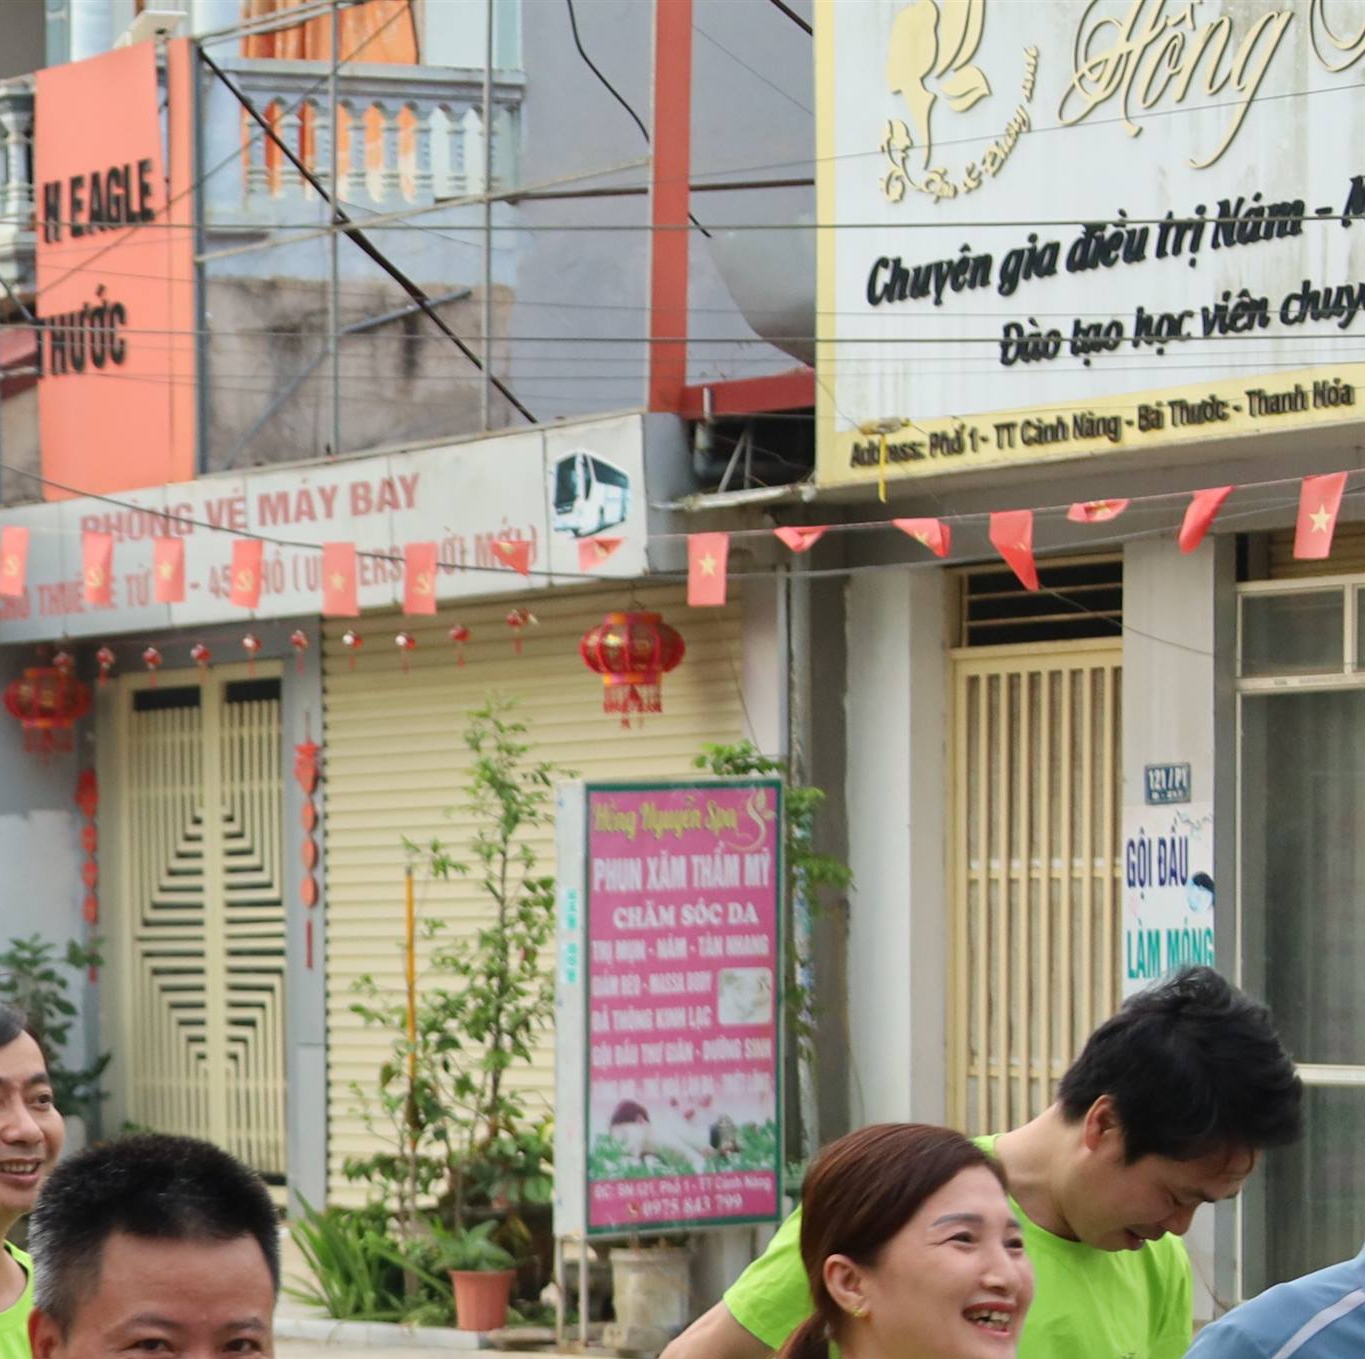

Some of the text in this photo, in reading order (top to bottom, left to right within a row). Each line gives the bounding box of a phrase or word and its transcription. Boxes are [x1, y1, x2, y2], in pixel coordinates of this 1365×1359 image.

[69, 158, 156, 239] EAGLE
[867, 243, 993, 306] Chuyên
[998, 233, 1061, 296] gia
[1065, 208, 1149, 272] điều
[1155, 204, 1207, 269] trị
[1211, 192, 1305, 250] Nám
[1000, 317, 1063, 366] Đào
[1069, 318, 1123, 367] tạo
[1131, 306, 1194, 356] học
[1200, 289, 1270, 337] viên
[994, 423, 1017, 449] TT
[1246, 384, 1307, 417] Thanh
[258, 478, 339, 527] MÁY
[350, 472, 419, 517] BAY
[592, 856, 642, 894] PHUN
[1126, 816, 1189, 900] GỘI ĐẦU
[726, 901, 760, 925] DA
[1127, 917, 1161, 980] LÀM
